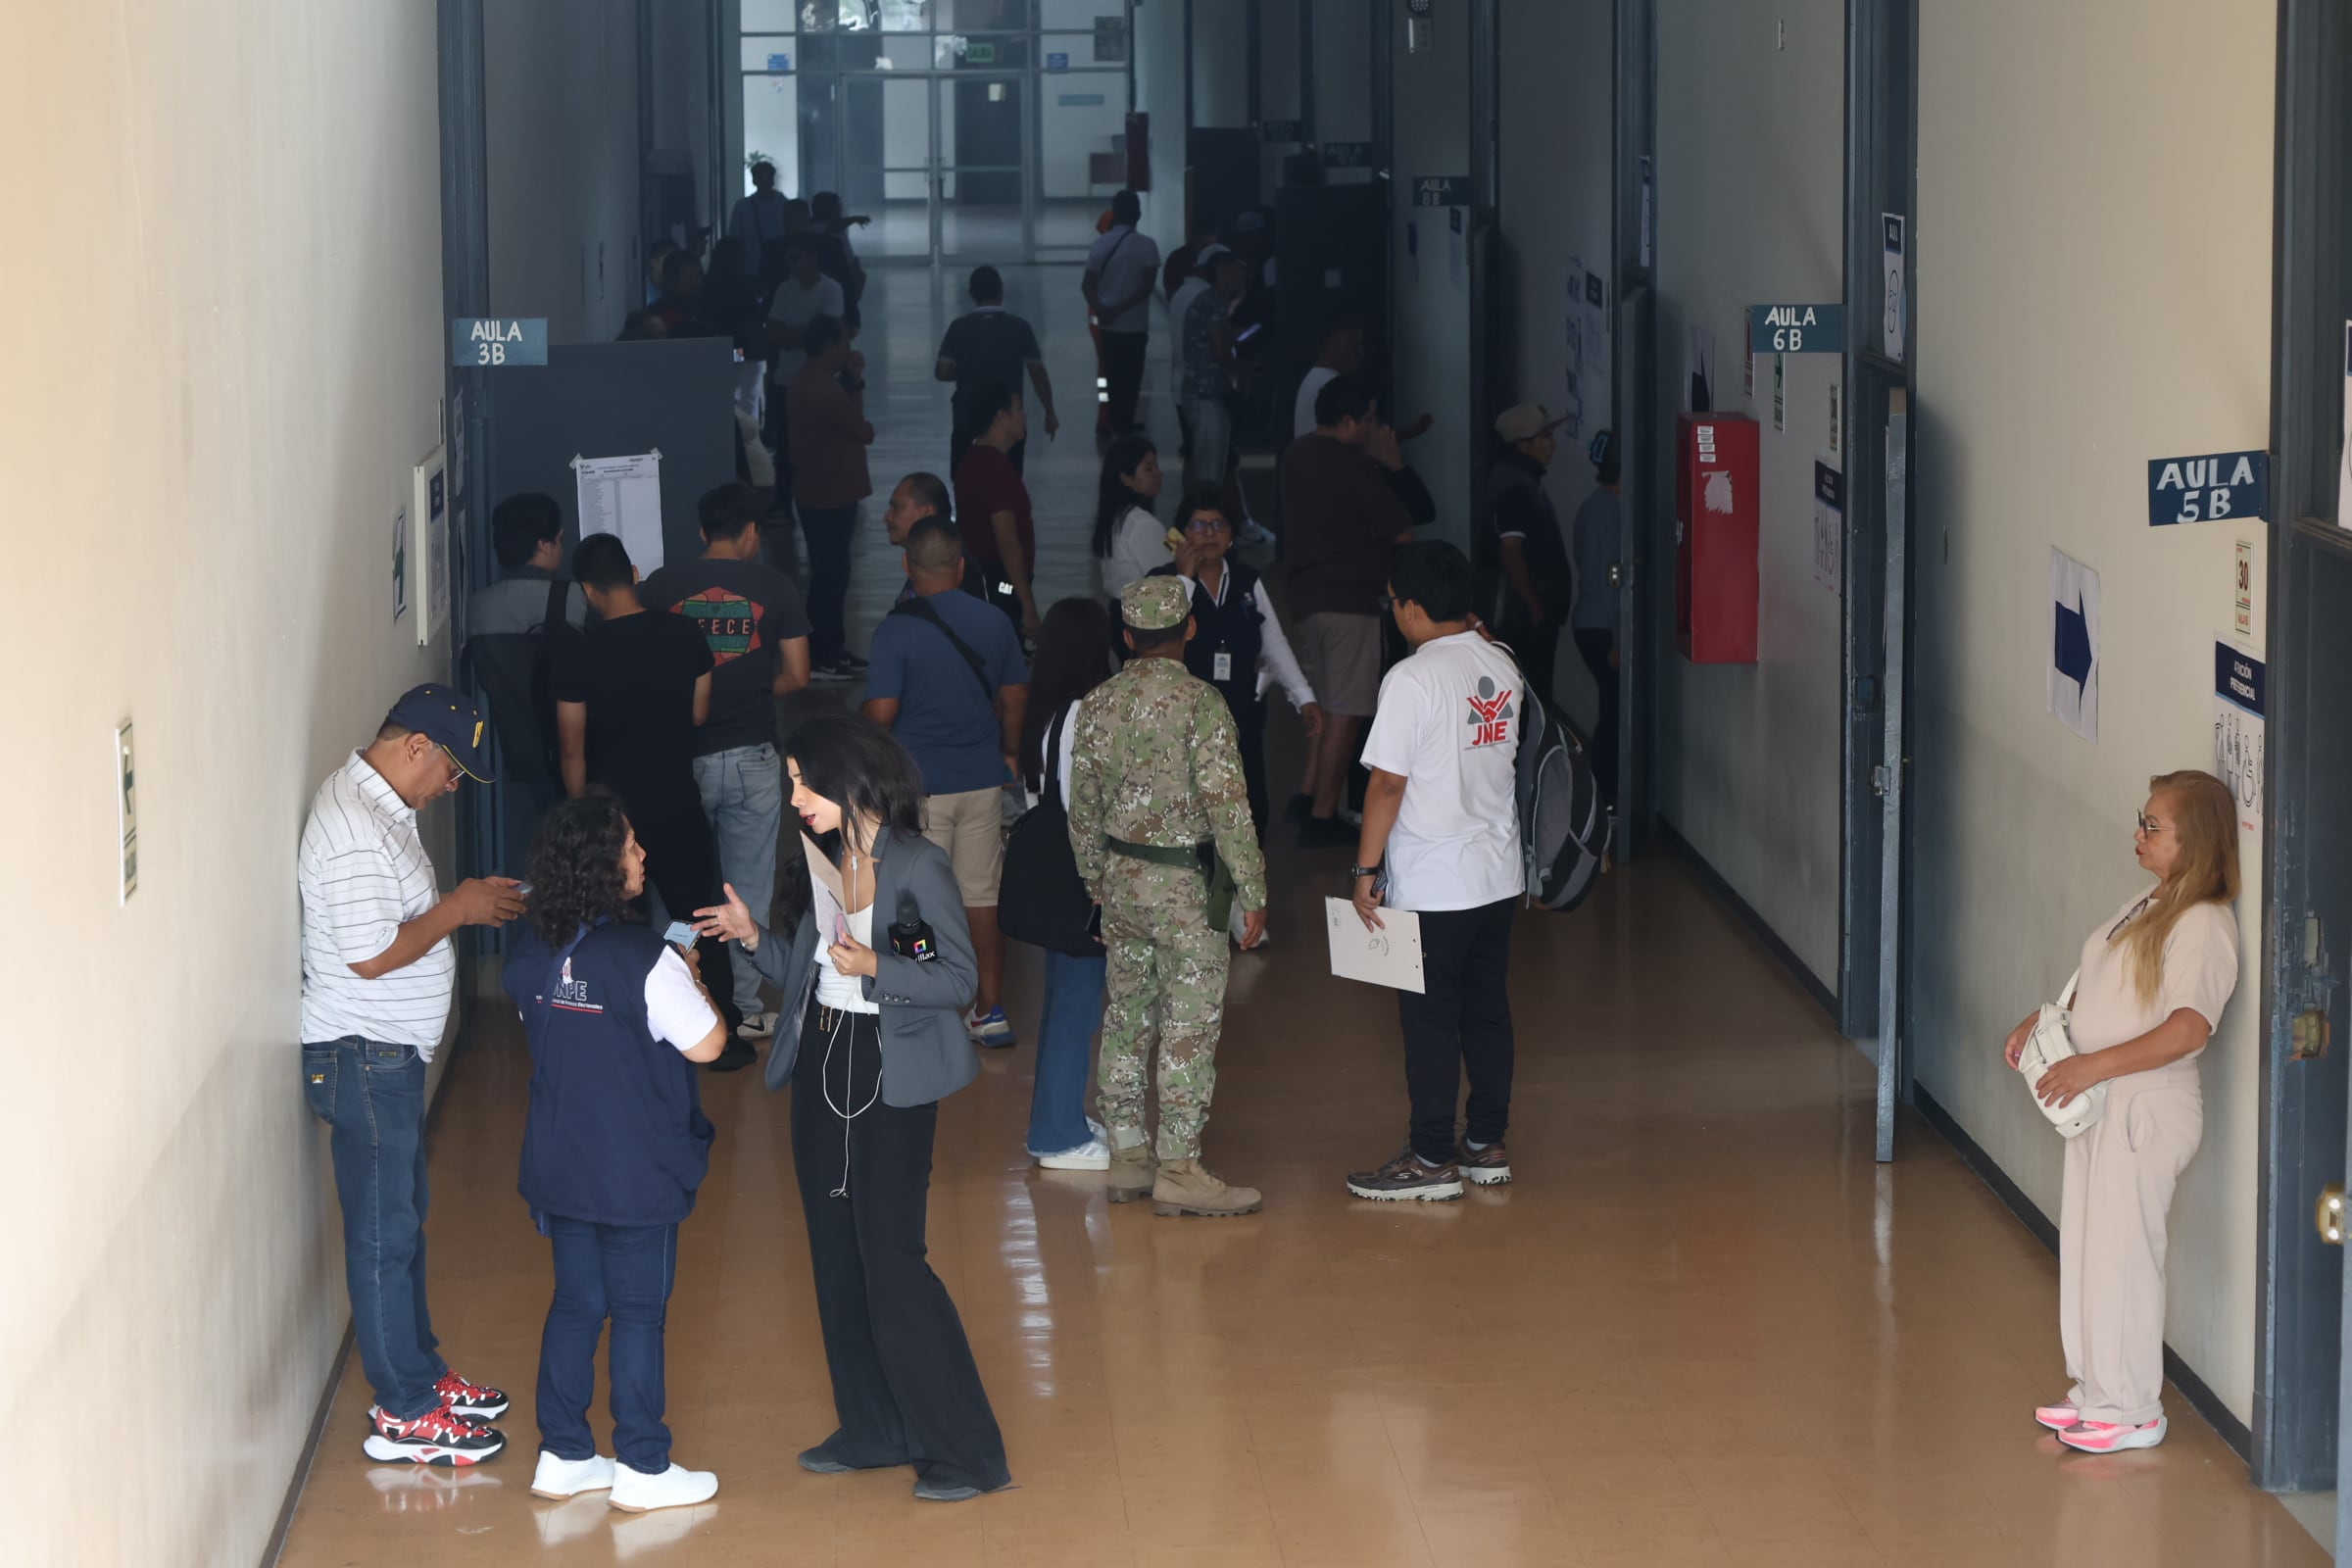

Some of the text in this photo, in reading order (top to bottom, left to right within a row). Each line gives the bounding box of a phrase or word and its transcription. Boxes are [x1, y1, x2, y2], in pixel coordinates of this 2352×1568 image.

[1420, 178, 1451, 191] AULA
[1765, 306, 1817, 326] AULA
[470, 319, 523, 342] AULA
[477, 342, 506, 366] 3B
[2156, 456, 2255, 491] AULA
[2238, 560, 2249, 591] 30
[998, 581, 1013, 595] CAT
[1472, 720, 1508, 746] JNE
